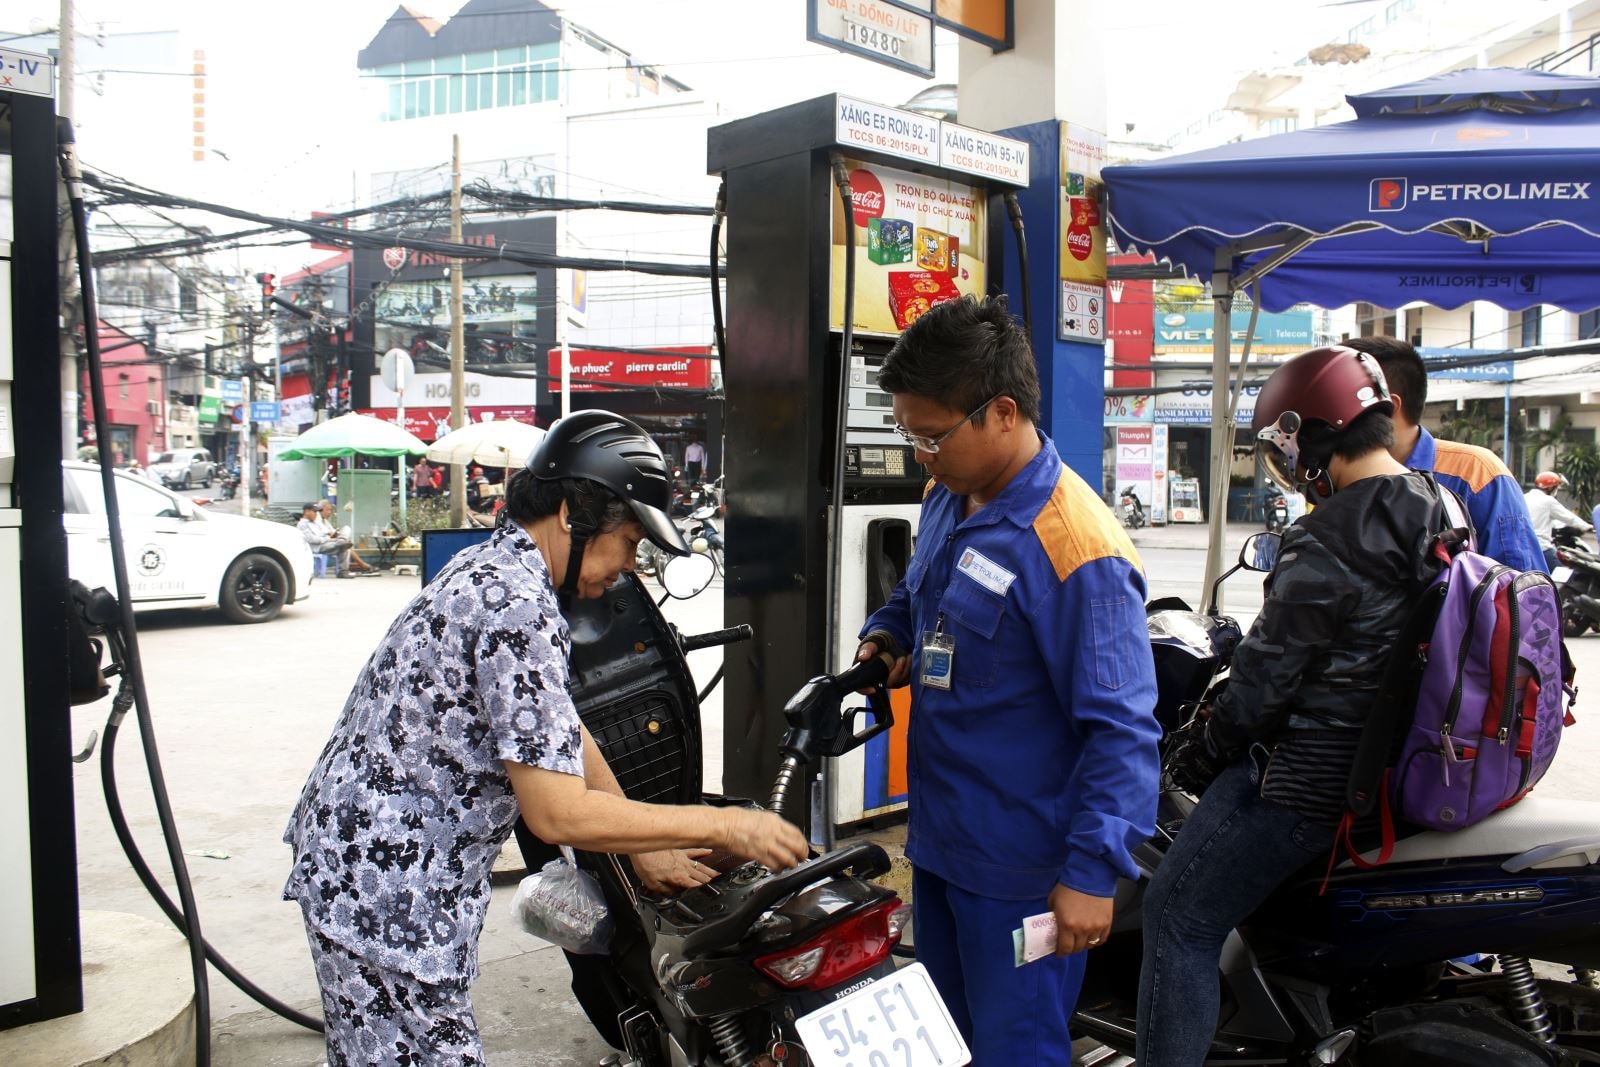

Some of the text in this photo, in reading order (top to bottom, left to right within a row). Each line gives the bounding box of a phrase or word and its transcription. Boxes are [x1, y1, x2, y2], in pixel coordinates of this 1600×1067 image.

[850, 24, 900, 55] 19480
[841, 104, 870, 126] XĂNG
[873, 113, 886, 131] E5
[888, 116, 910, 137] RON
[848, 128, 873, 144] TCCS
[945, 131, 974, 153] XĂNG
[976, 140, 998, 159] RON
[951, 154, 973, 168] TCCS
[1412, 182, 1591, 201] PETROLIMEX
[1276, 330, 1308, 338] Telecom
[626, 362, 655, 375] pierre
[656, 360, 688, 372] cardin
[1120, 431, 1145, 441] Triumph
[835, 976, 876, 1000] HONDA
[818, 981, 920, 1058] 54-F1
